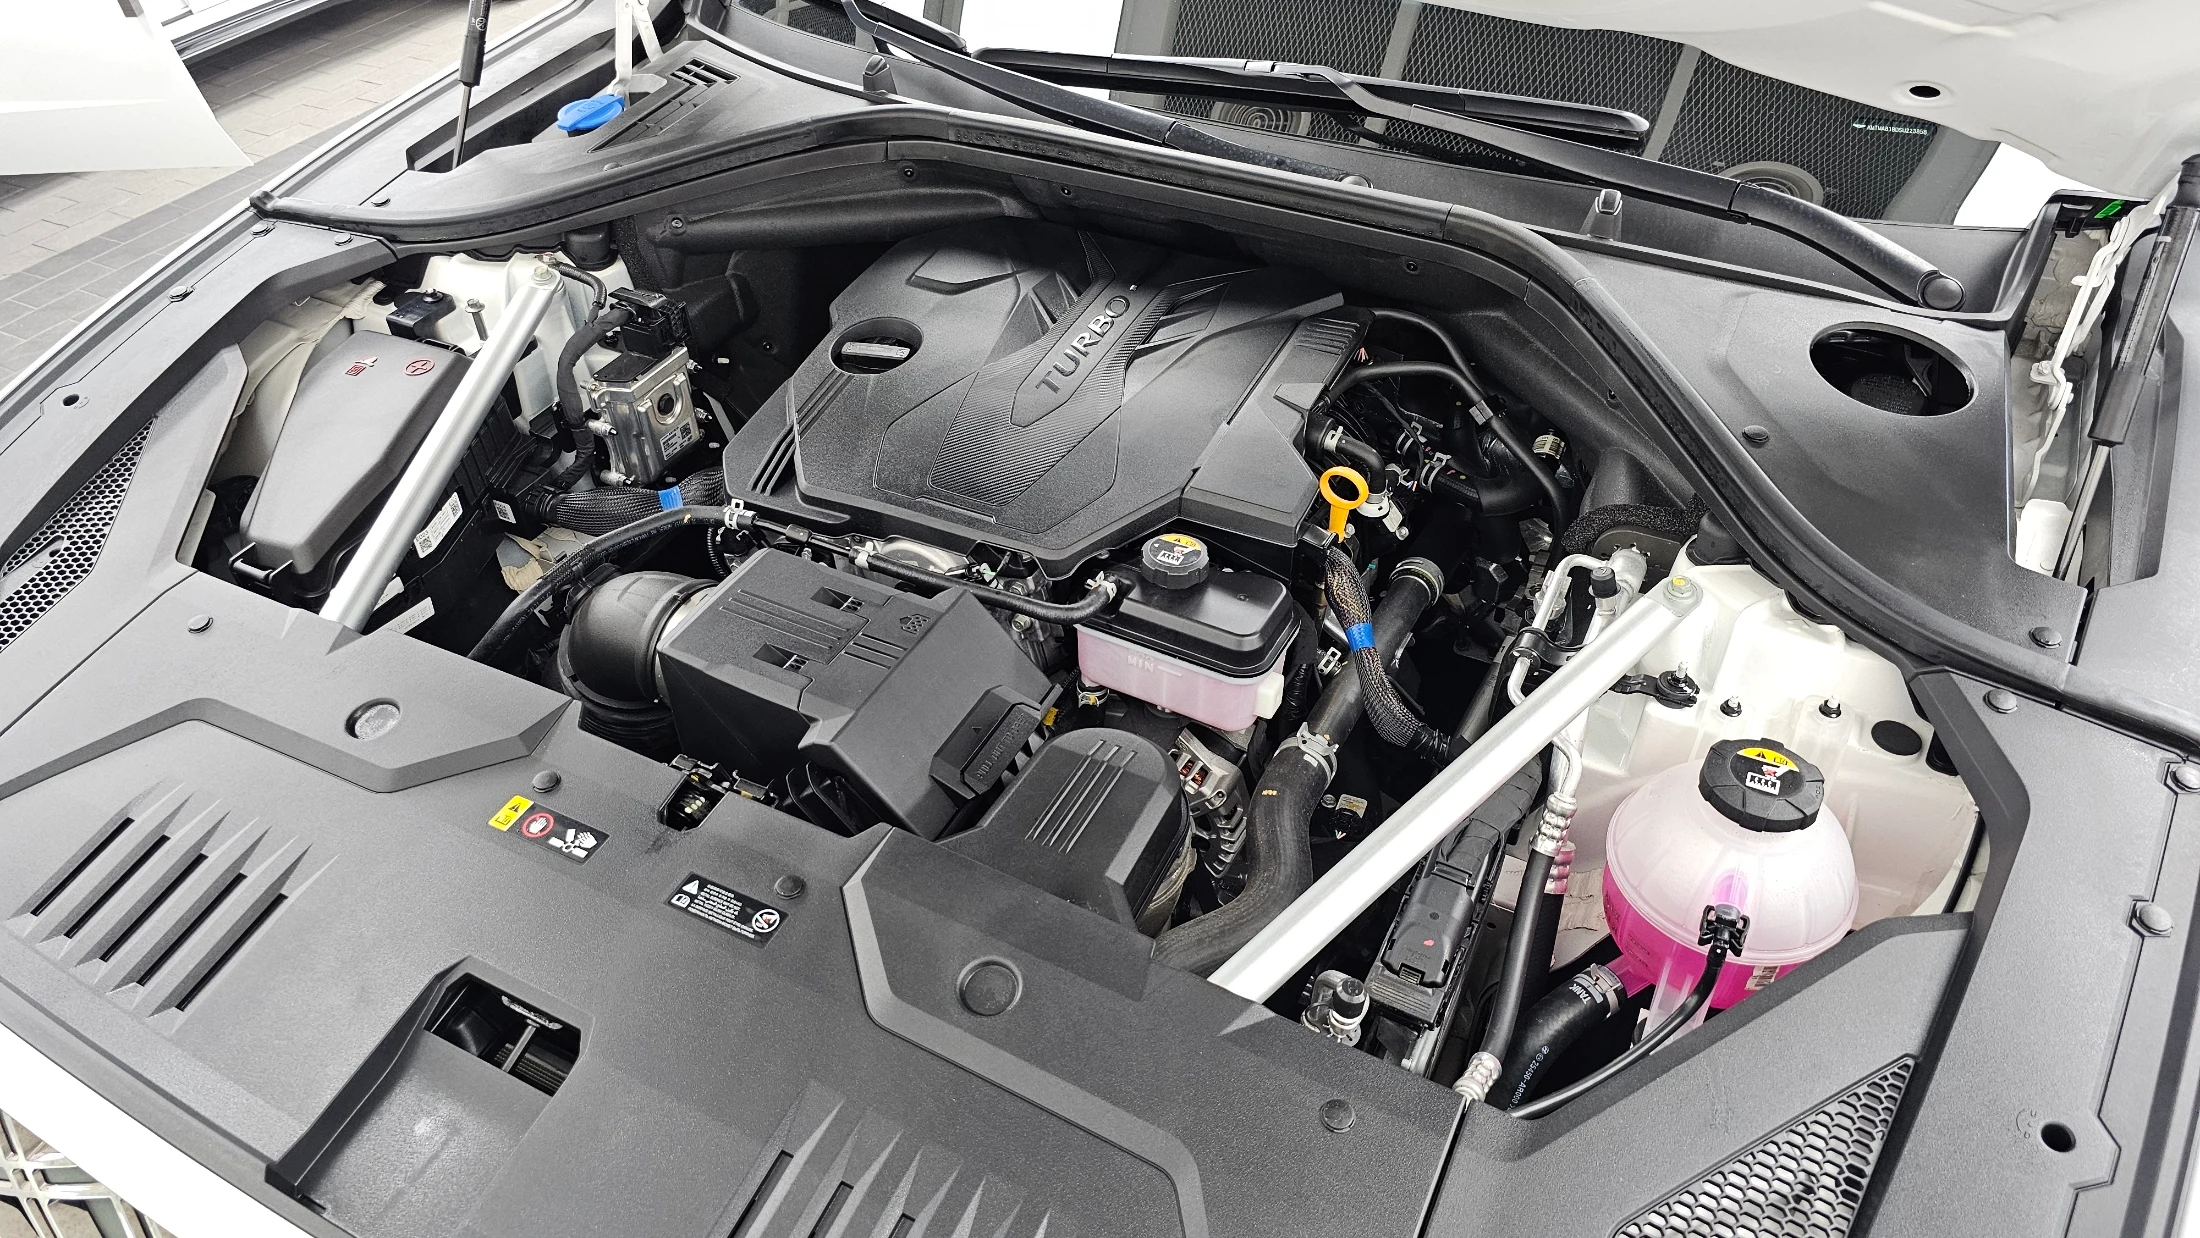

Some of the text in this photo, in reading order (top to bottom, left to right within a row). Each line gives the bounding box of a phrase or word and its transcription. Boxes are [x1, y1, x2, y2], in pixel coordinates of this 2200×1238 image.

[1035, 295, 1131, 394] TURBO
[1127, 655, 1154, 673] MIN
[1569, 983, 1591, 1005] TANK
